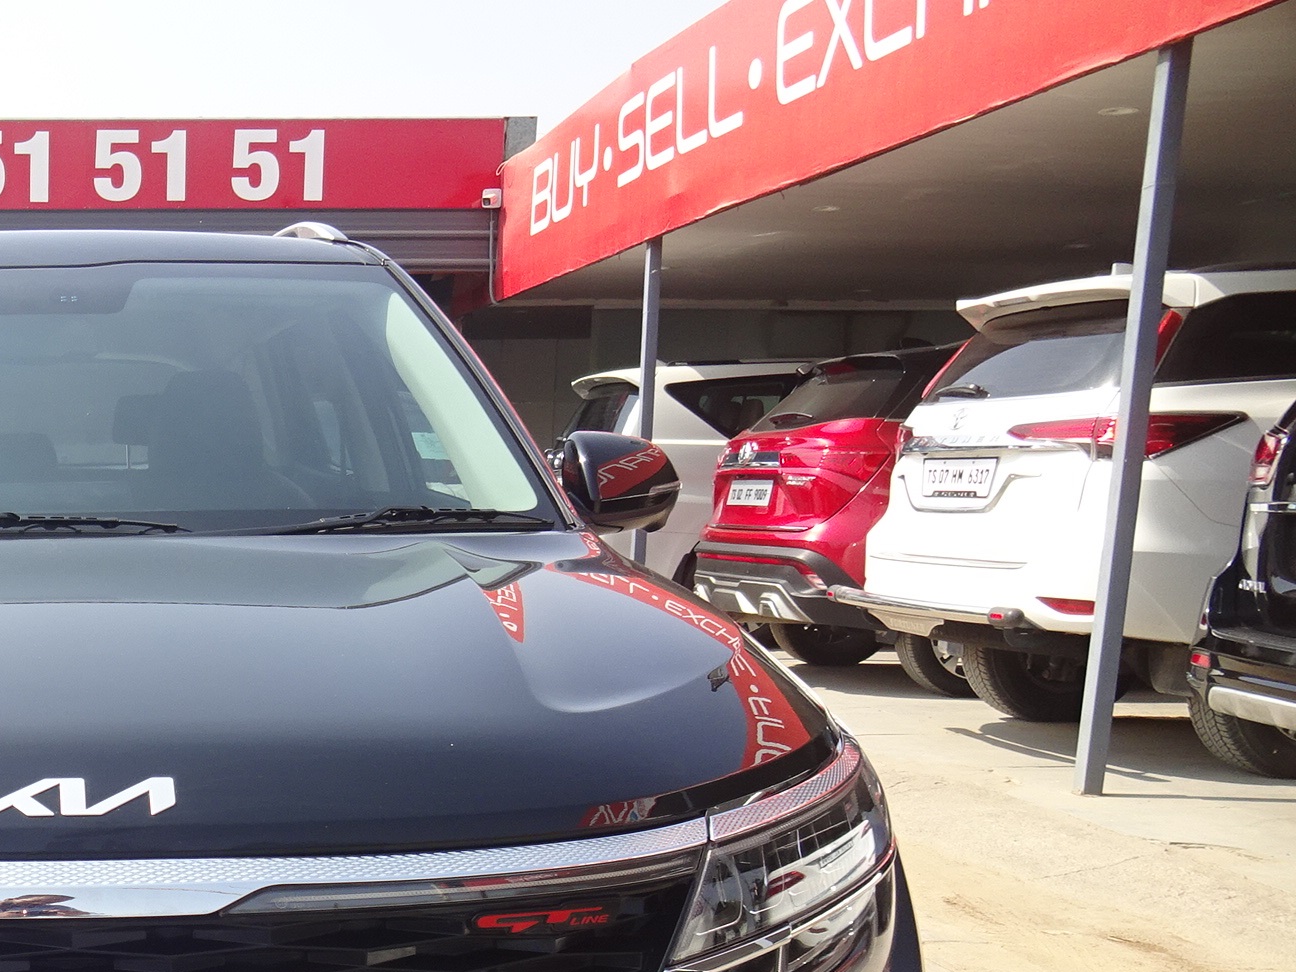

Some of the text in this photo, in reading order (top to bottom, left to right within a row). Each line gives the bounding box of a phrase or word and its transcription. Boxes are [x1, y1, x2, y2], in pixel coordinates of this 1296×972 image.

[93, 129, 187, 202] 51
[231, 128, 325, 201] 51
[530, 123, 600, 236] BUY
[617, 46, 744, 188] SELL
